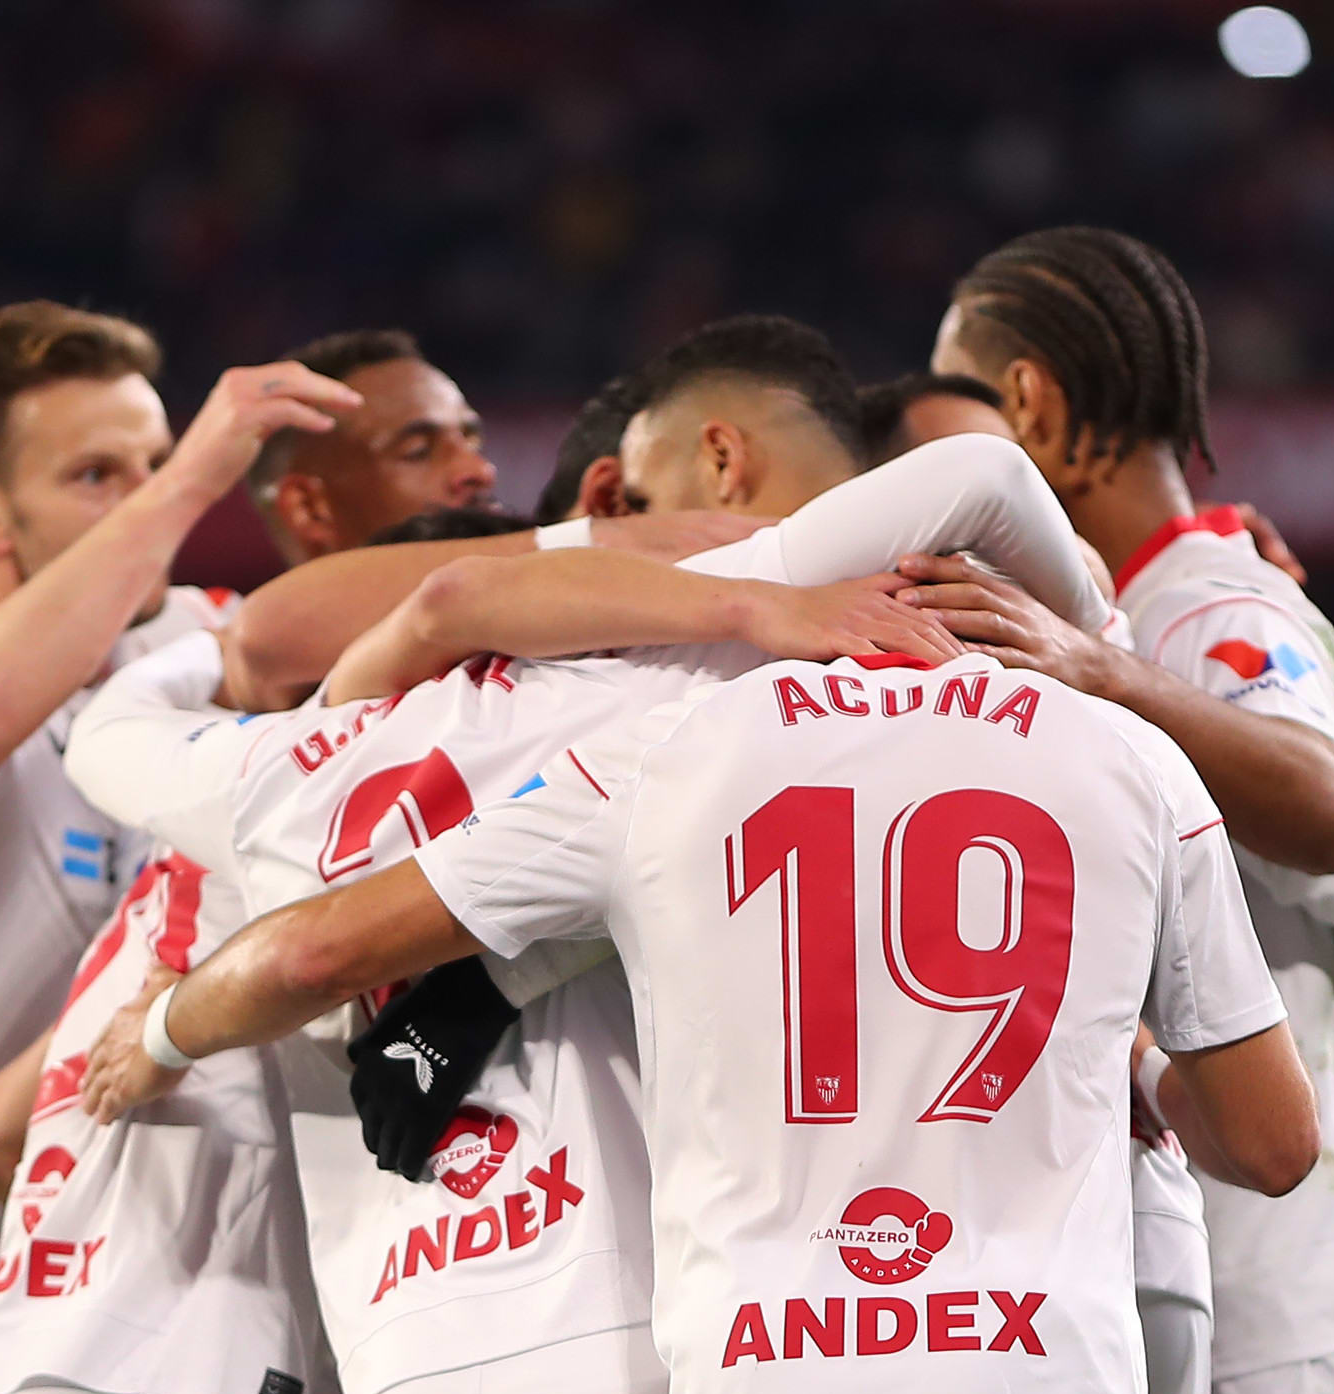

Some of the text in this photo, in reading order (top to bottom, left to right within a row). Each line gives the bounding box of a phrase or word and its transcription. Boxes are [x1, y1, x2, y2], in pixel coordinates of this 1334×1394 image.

[725, 785, 1075, 1124] 19
[369, 1145, 585, 1304] ANDEX
[809, 1228, 909, 1244] PLANTAZERO
[850, 1258, 913, 1277] ANDEX
[721, 1290, 1048, 1368] ANDEX
